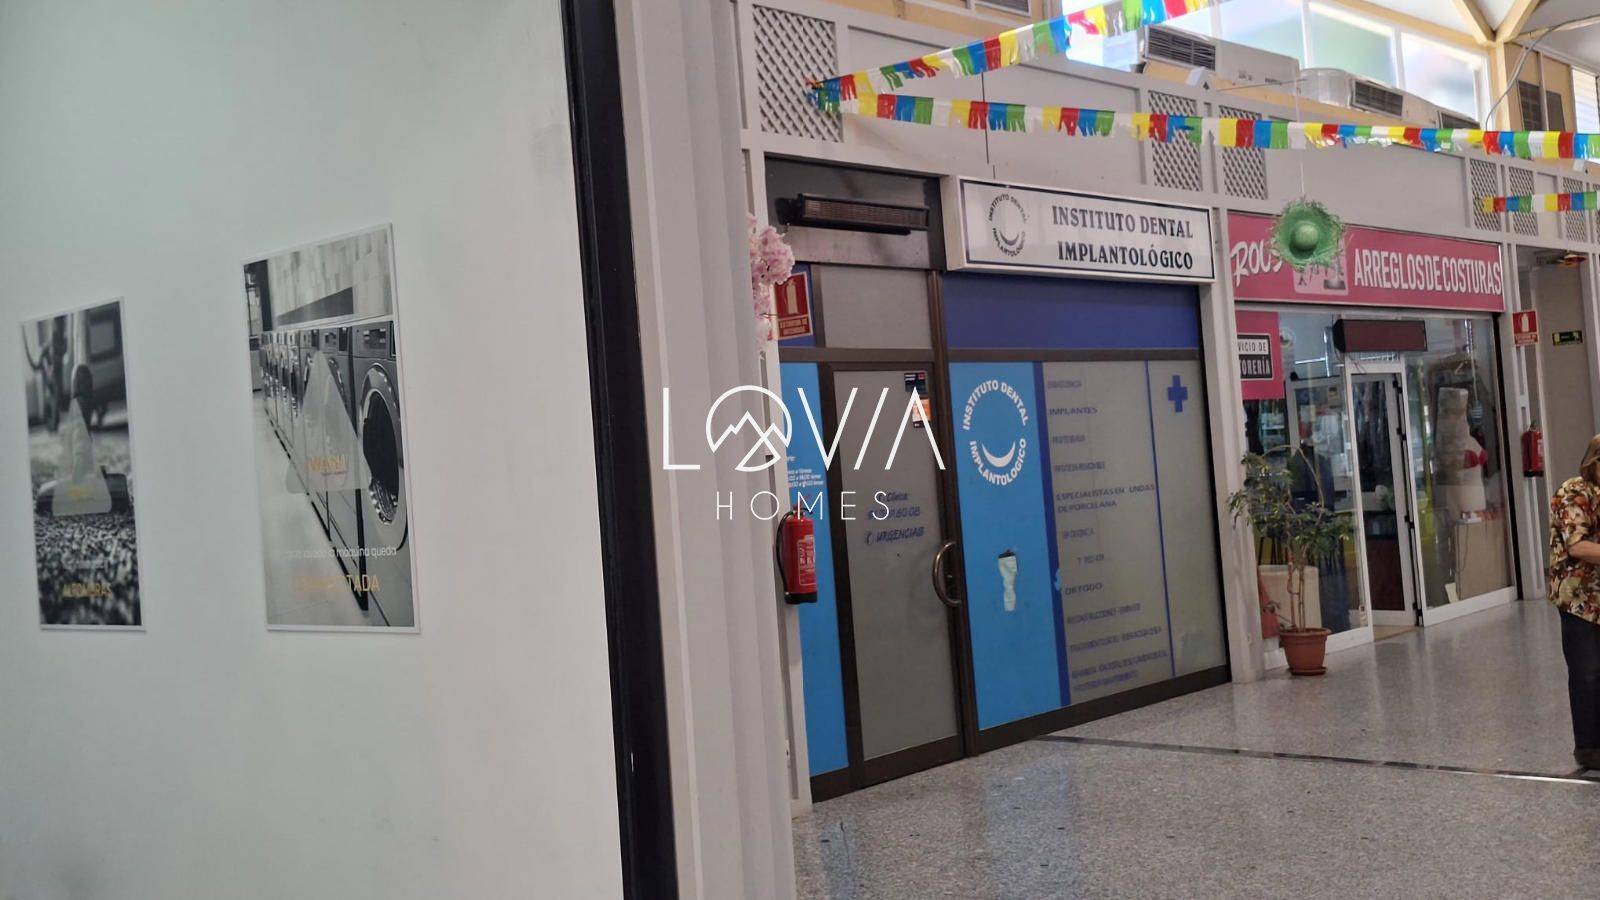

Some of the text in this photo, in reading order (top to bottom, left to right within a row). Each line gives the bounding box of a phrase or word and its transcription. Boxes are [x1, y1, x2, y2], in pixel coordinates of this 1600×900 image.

[1051, 205, 1194, 239] INSTITUTO DENTAL
[1057, 241, 1194, 270] IMPLANTOLÓGICO
[1354, 248, 1502, 295] ARREGLOS DE COSTURAS
[1258, 342, 1267, 352] DE
[962, 379, 1029, 431] INSTITUTO DENTAL
[969, 438, 1026, 486] IMPLANTOLOGICO
